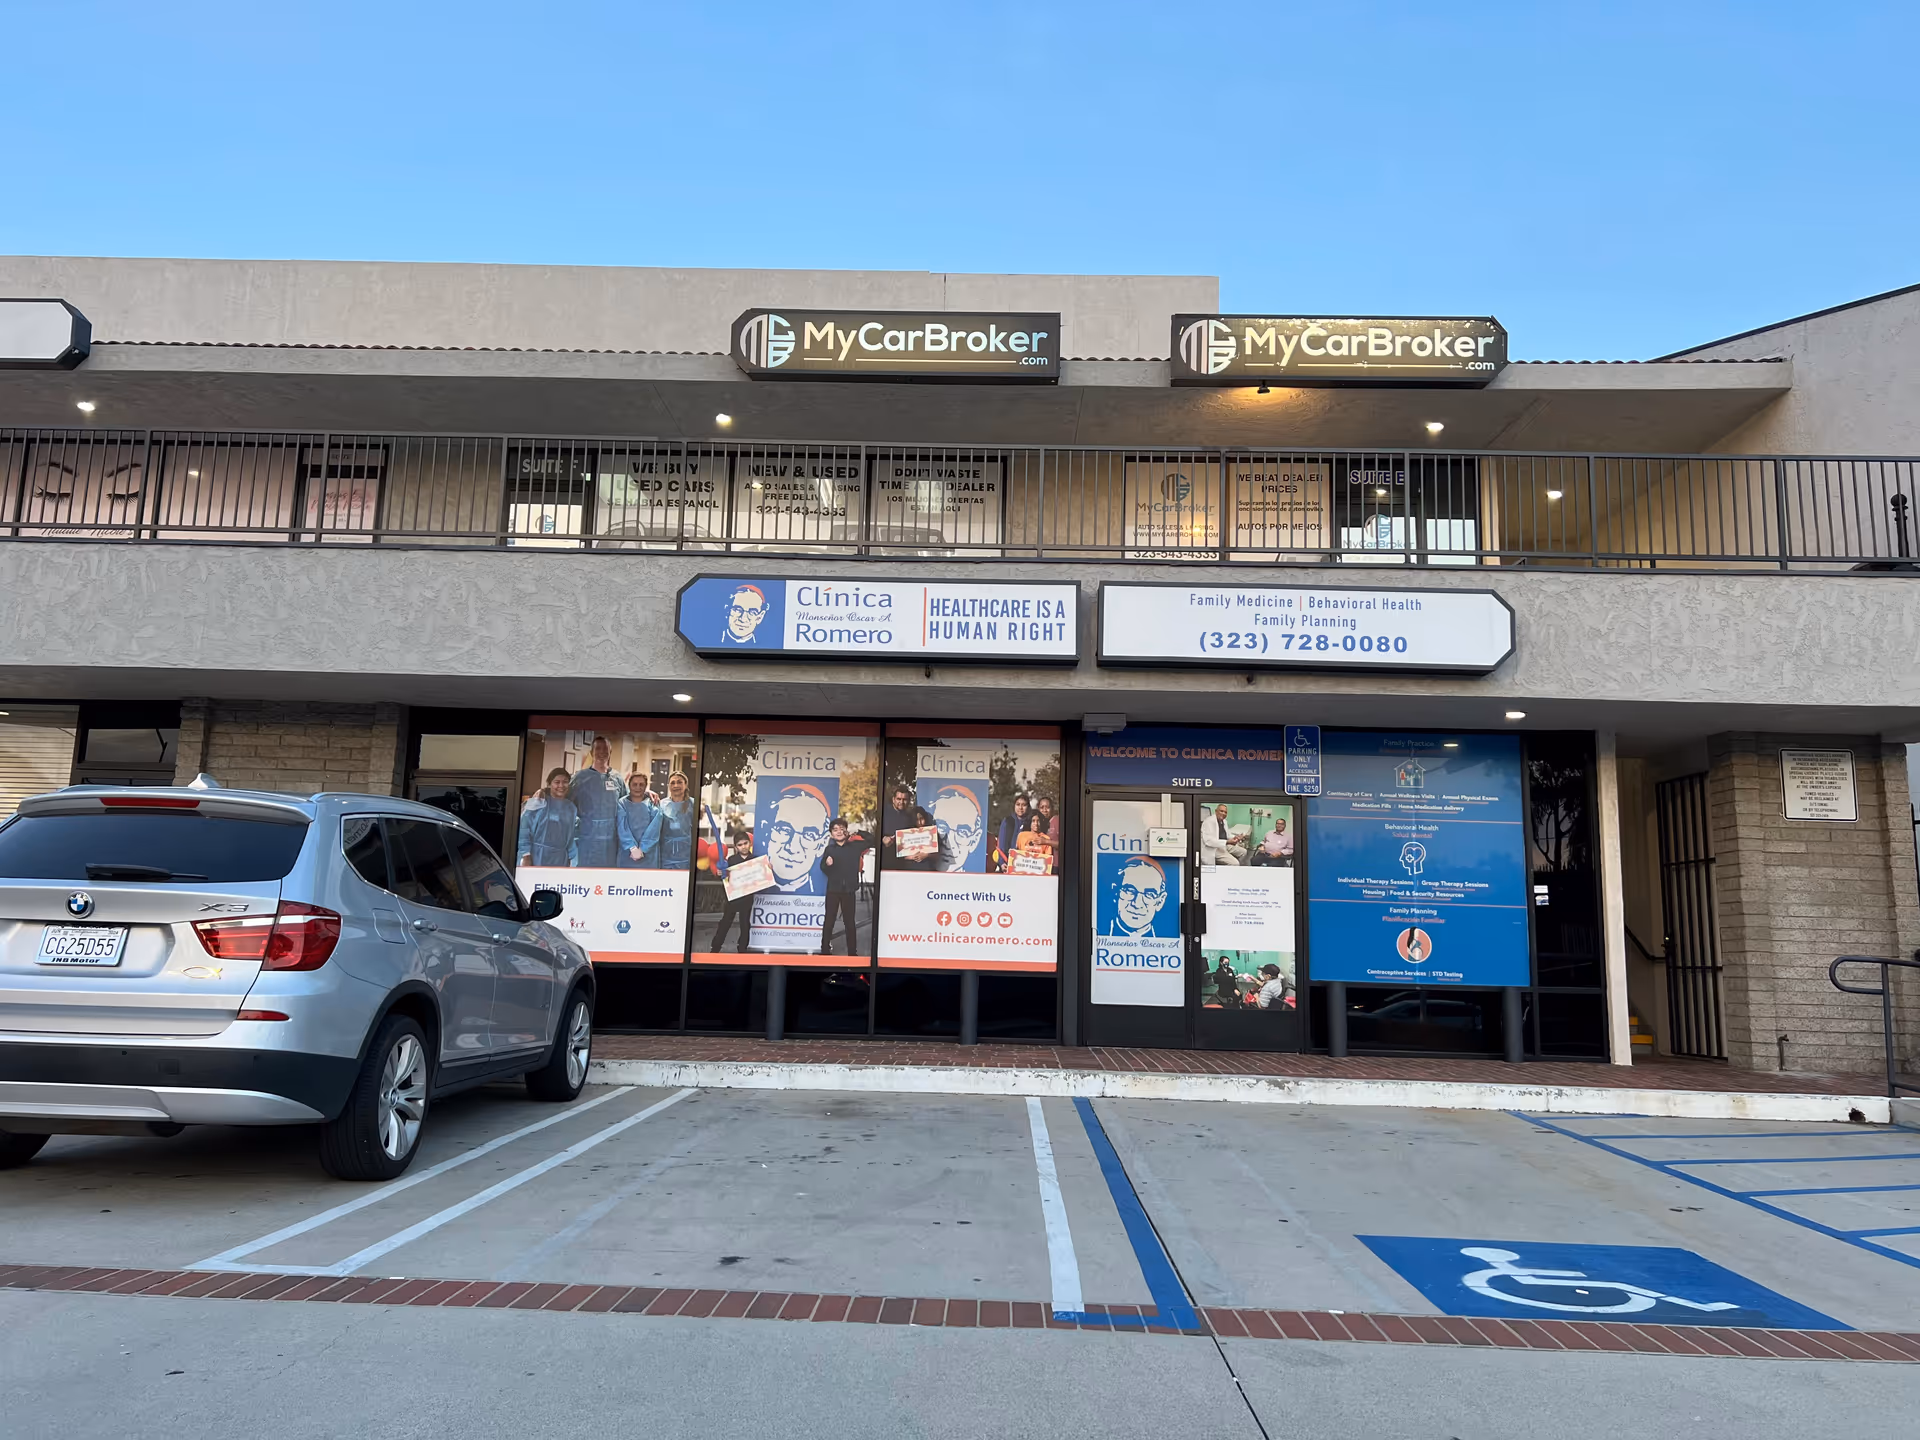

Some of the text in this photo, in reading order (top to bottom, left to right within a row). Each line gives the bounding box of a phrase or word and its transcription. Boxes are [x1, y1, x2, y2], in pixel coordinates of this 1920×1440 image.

[803, 321, 1048, 361] MyCarBroker
[1245, 326, 1494, 367] MyCarBroker
[1019, 355, 1048, 365] .com
[1465, 361, 1495, 371] .com
[522, 458, 562, 474] SUITE
[632, 462, 658, 475] WE
[748, 465, 859, 478] NEW & USED
[936, 469, 980, 479] WASTE
[1350, 469, 1405, 485] SUITE E
[668, 480, 715, 493] CARS
[945, 482, 995, 492] DEALER
[1261, 485, 1298, 494] PRICES
[764, 492, 790, 500] FREE
[1269, 523, 1288, 531] POR
[796, 586, 893, 609] Clínica
[1190, 593, 1293, 609] Family Medicine
[1309, 596, 1422, 611] Behavioral Health
[929, 598, 1066, 619] HEALTHCARE IS A
[795, 611, 844, 622] Monseñor
[848, 611, 875, 623] Oscar
[1254, 613, 1357, 631] Family Planning
[795, 624, 893, 644] Romero
[929, 620, 1065, 642] HUMAN RIGHT
[1200, 631, 1408, 653] (323) 728-0080
[1088, 746, 1157, 758] WELCOME
[1160, 747, 1179, 759] TO
[1182, 748, 1235, 761] CLINICA
[1288, 747, 1317, 755] PARKING
[762, 751, 836, 771] Clínica
[920, 754, 986, 774] Clínica
[1294, 755, 1311, 763] ONLY
[1172, 777, 1213, 787] SUITE D
[1291, 776, 1315, 784] MINIMUM
[1287, 784, 1319, 793] FINE $250
[1460, 794, 1481, 802] Physical
[1384, 823, 1417, 831] Behavioral
[1366, 878, 1389, 886] Therapy
[1440, 880, 1464, 888] Therapy
[534, 883, 674, 898] Eligibility & Enrollment
[926, 890, 1012, 902] Connect With Us
[1411, 890, 1434, 898] Security
[198, 903, 249, 912] X3
[888, 931, 1053, 947] www.clinicaromero.com
[1096, 936, 1138, 948] Monseñor
[1140, 939, 1167, 949] Oscar
[45, 936, 116, 956] CG25D55
[1096, 948, 1181, 969] Romero
[1366, 968, 1403, 976] Contraceptive
